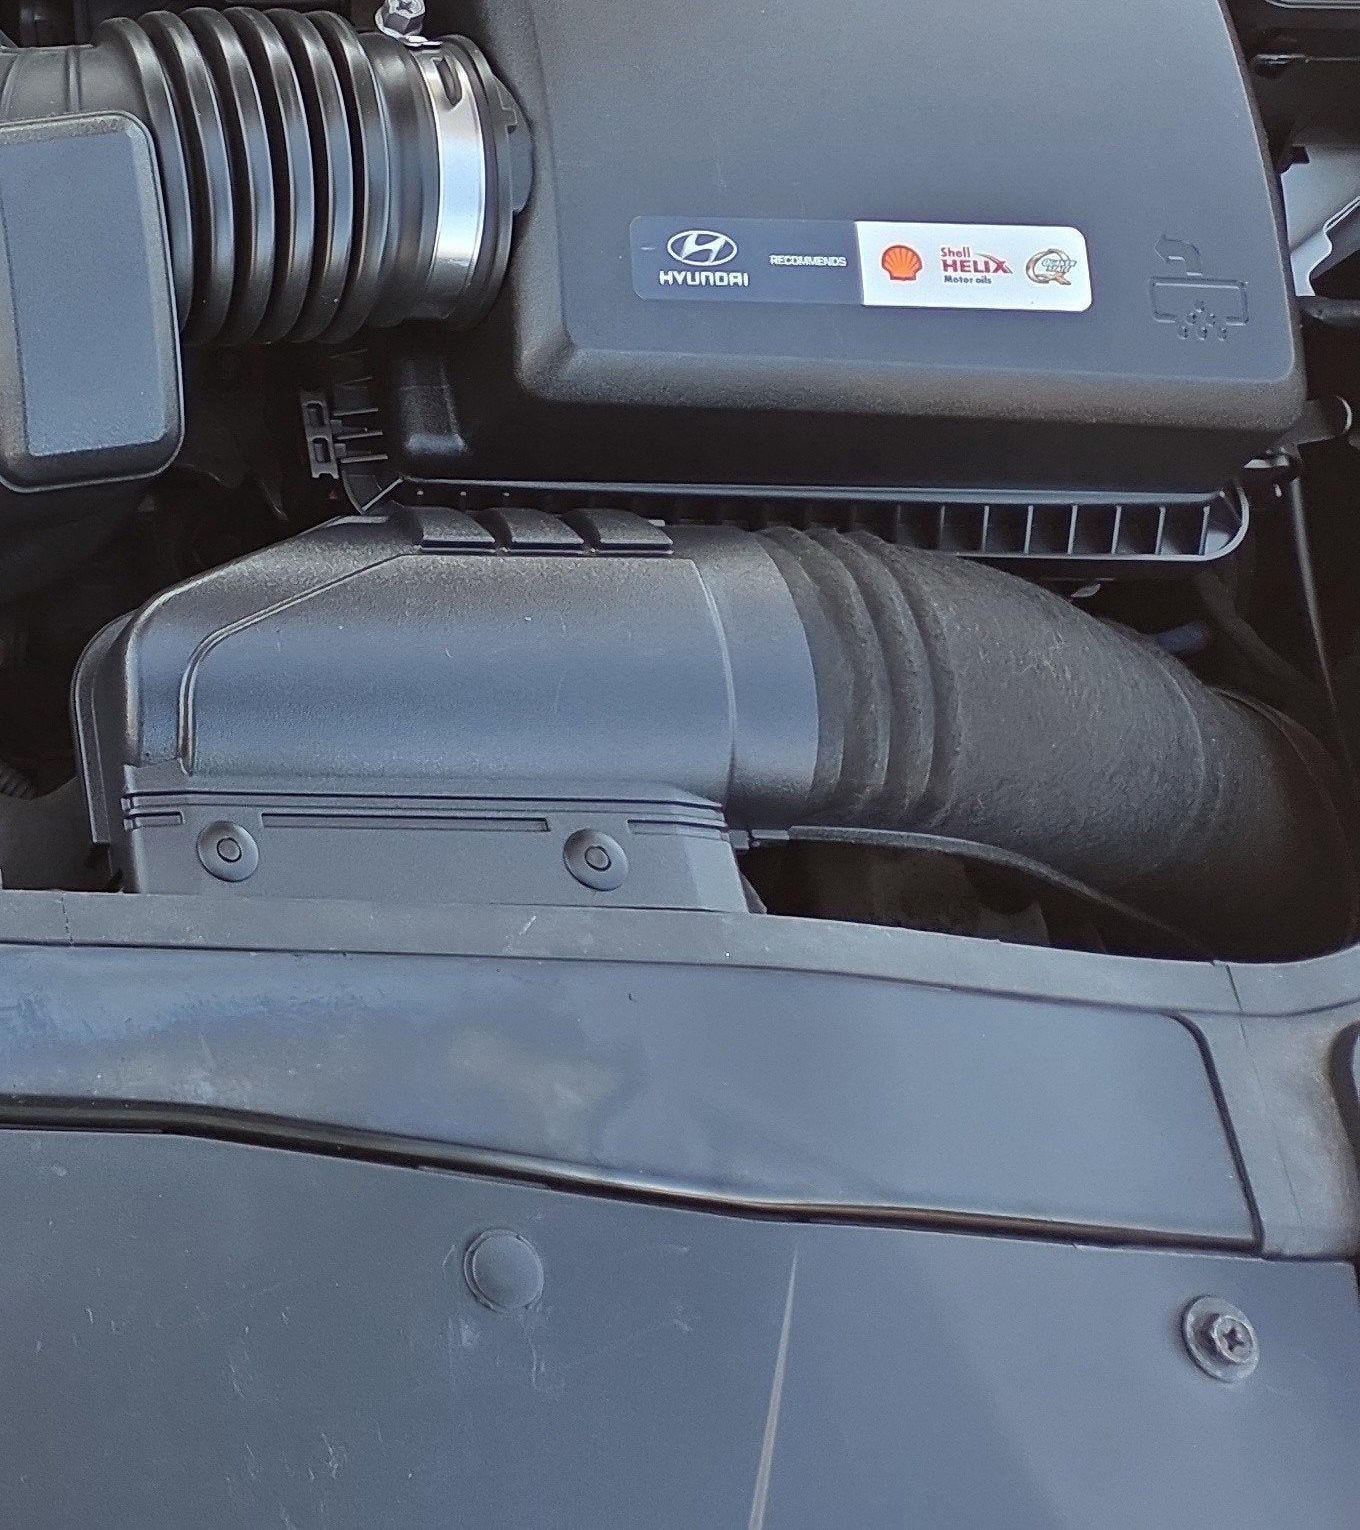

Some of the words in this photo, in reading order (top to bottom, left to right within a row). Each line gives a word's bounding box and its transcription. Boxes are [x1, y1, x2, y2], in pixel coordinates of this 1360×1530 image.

[940, 245, 972, 258] Shell
[769, 254, 847, 268] RECOMMENDS
[942, 254, 1013, 274] HELIX
[658, 271, 749, 288] HYUNDAI
[944, 274, 974, 285] Motor
[976, 274, 992, 285] oils
